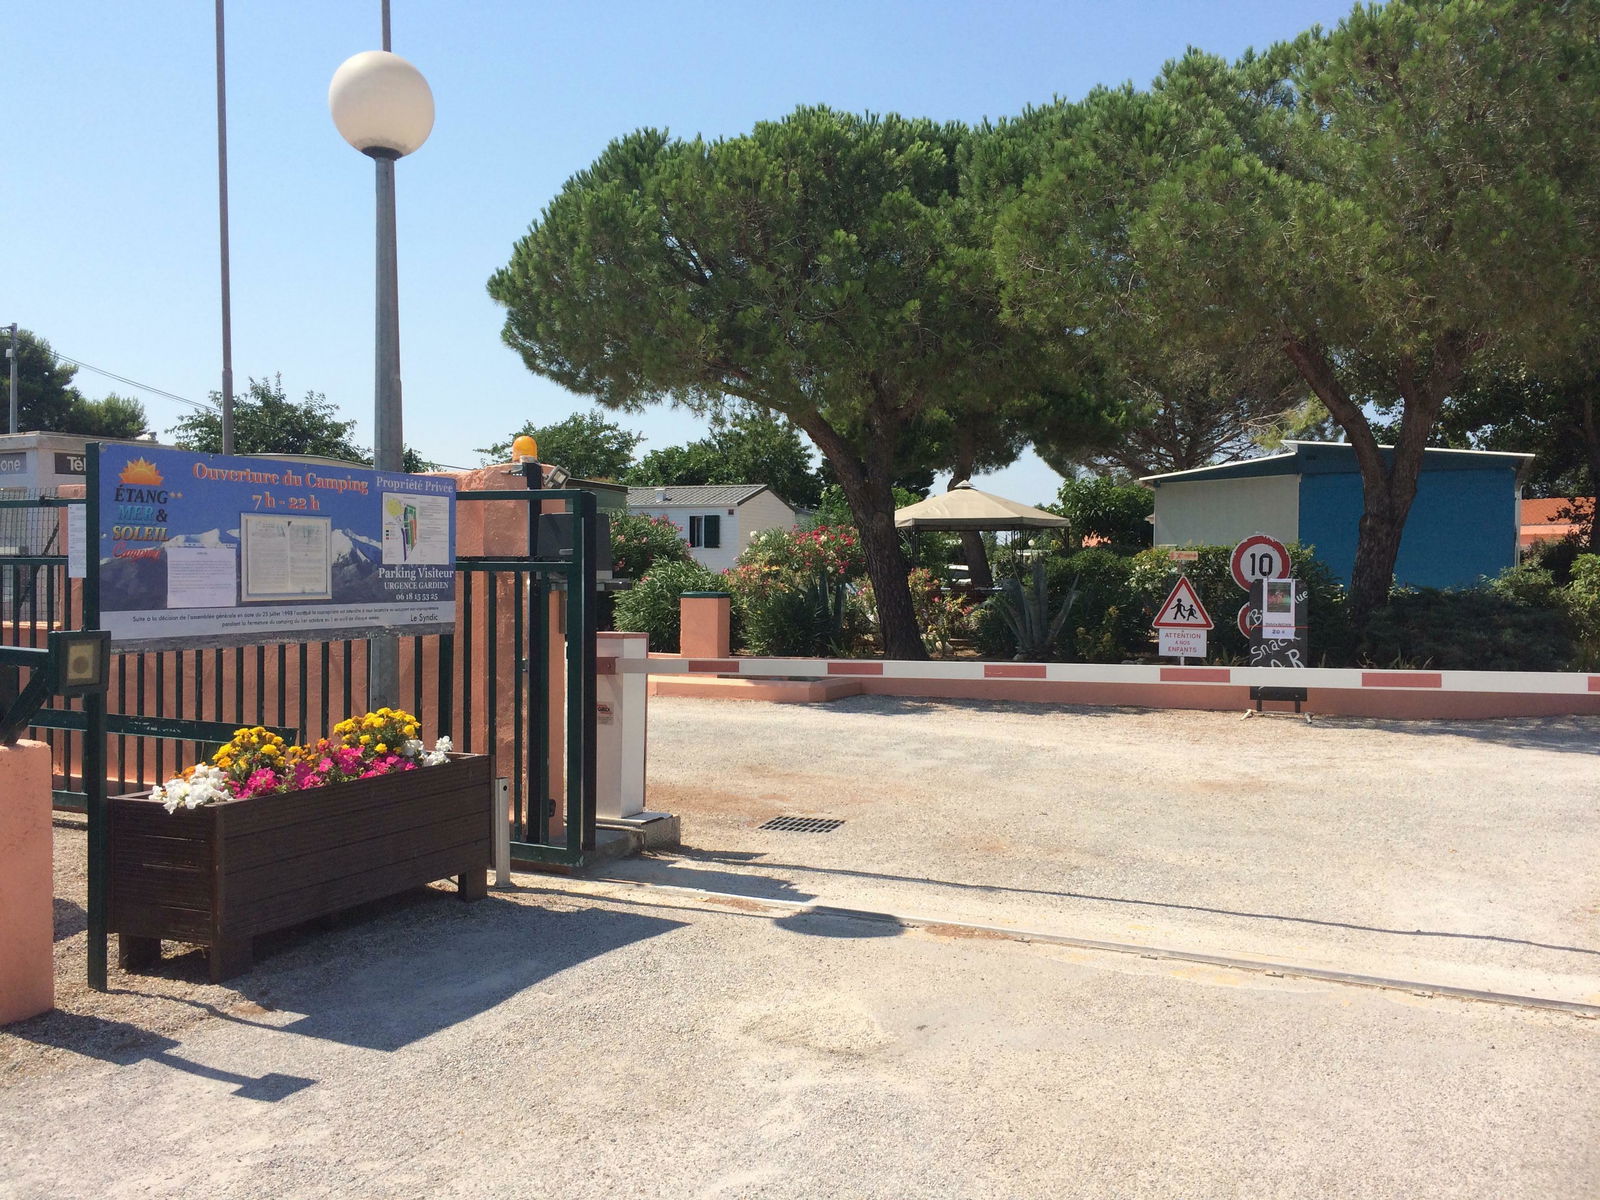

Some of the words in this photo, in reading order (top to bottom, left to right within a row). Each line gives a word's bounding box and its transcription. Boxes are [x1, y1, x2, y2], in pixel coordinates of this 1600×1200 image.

[192, 462, 280, 486] Ouverture
[281, 469, 302, 487] du
[305, 472, 368, 496] Camping
[376, 476, 423, 491] Propriété
[425, 480, 454, 493] Privée
[114, 485, 169, 504] ÉTANG
[119, 504, 154, 521] MER
[155, 508, 168, 523] &
[112, 525, 170, 542] SOLEIL
[378, 566, 417, 581] Parking
[417, 566, 454, 579] Visiteur
[1249, 553, 1274, 577] 10
[384, 581, 418, 590] URGENCE
[418, 581, 449, 589] GARDIEN
[410, 614, 418, 622] Le
[418, 613, 438, 622] Syndic
